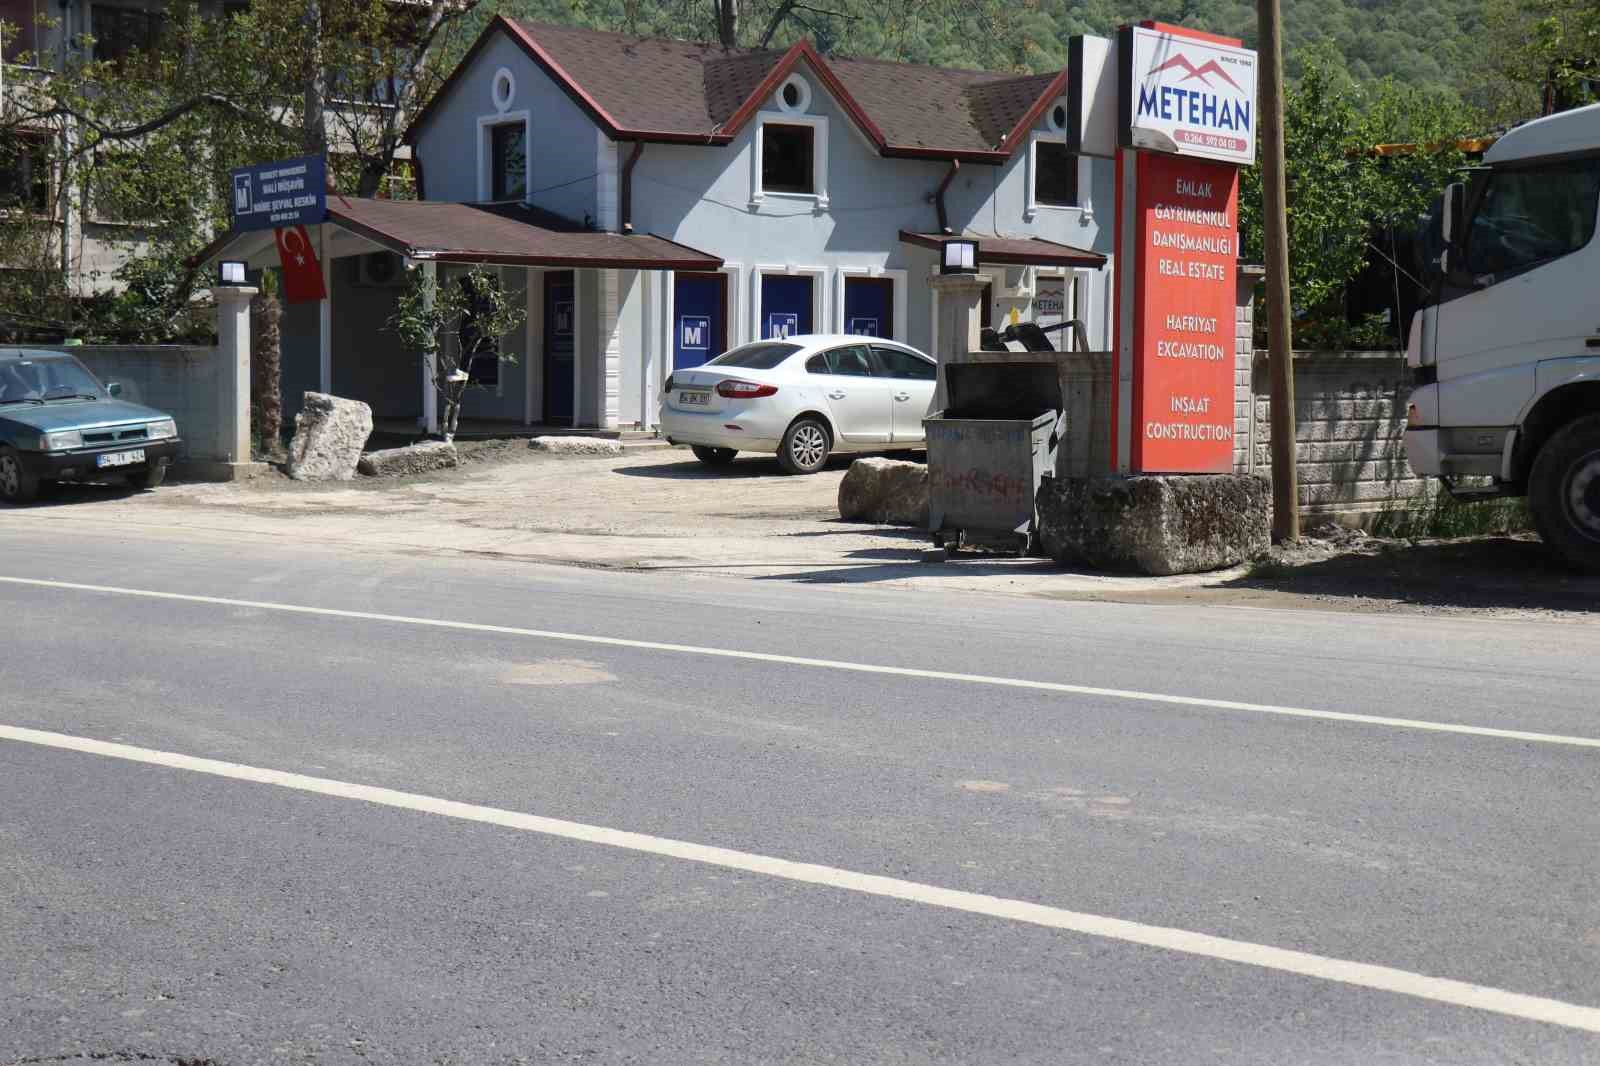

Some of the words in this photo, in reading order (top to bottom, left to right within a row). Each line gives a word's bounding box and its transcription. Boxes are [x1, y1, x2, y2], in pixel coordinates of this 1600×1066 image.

[1138, 83, 1250, 132] METEHAN
[1176, 178, 1212, 198] EMLAK
[1159, 258, 1186, 276] REAL
[1188, 261, 1225, 280] ESTATE
[1157, 341, 1224, 361] EXCAVATION
[1146, 421, 1232, 441] CONSTRUCTION
